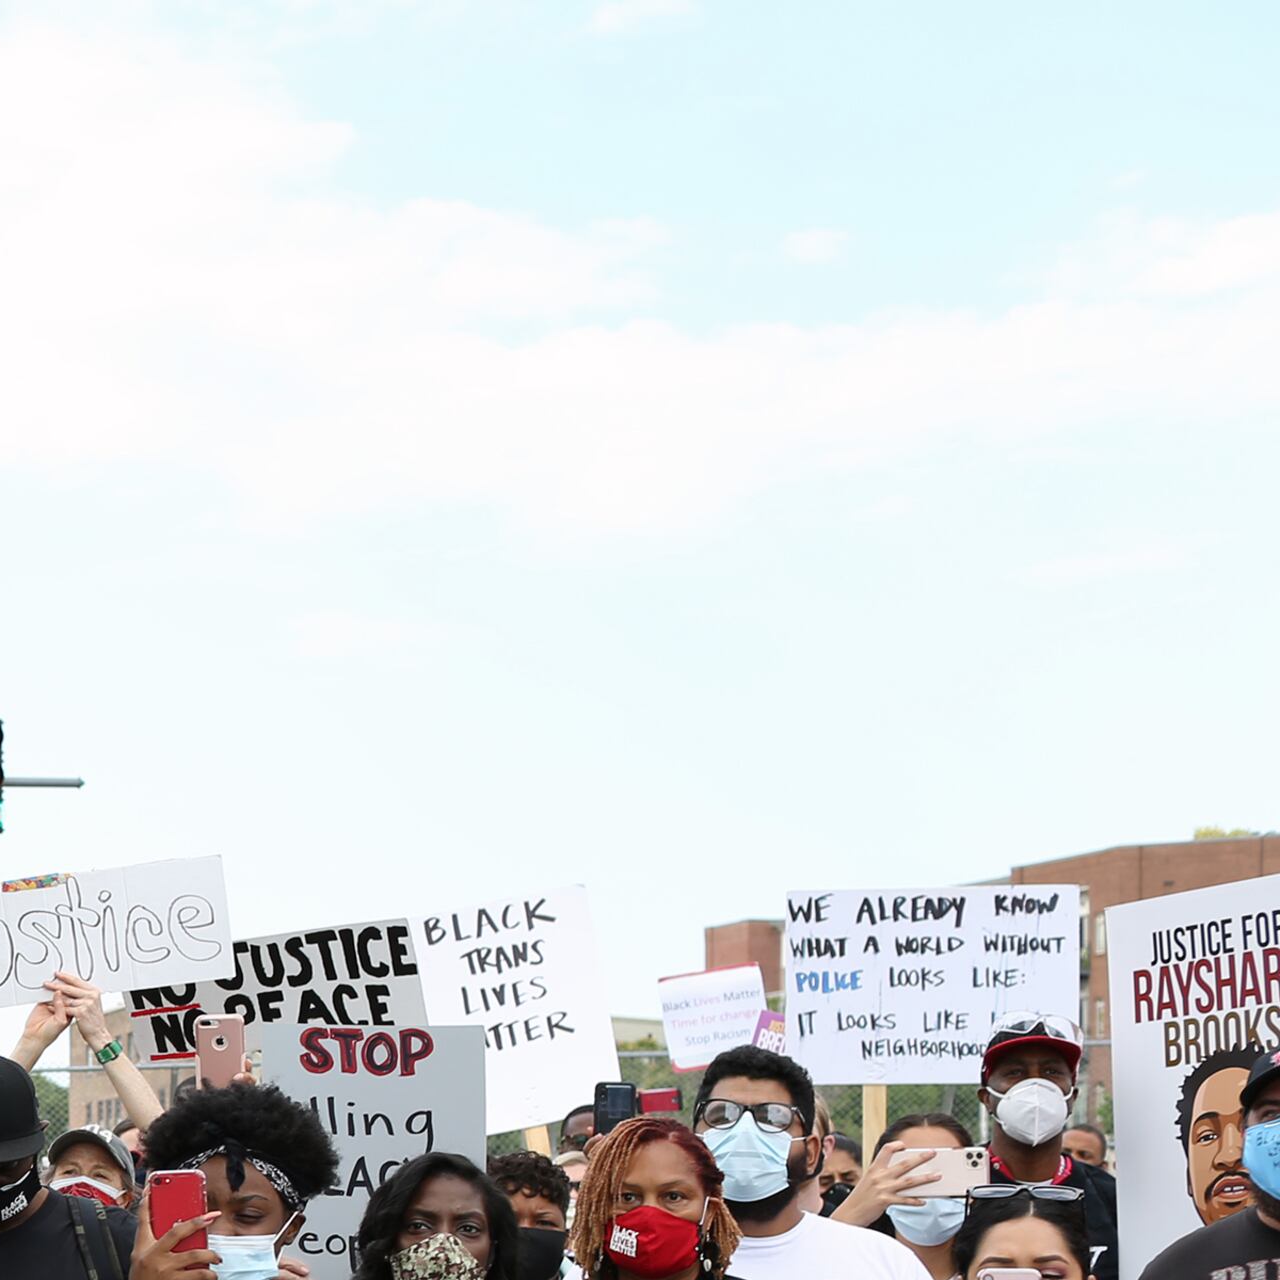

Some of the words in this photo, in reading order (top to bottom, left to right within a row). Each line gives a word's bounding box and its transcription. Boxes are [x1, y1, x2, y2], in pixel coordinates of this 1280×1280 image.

[423, 898, 557, 946] BLACK
[788, 893, 835, 923] WE
[856, 894, 966, 928] ALREADY
[994, 892, 1059, 916] KNOW
[215, 925, 418, 991] JUSTICE
[460, 939, 545, 977] TRANS
[790, 935, 850, 959] WHAT
[863, 935, 880, 954] A
[895, 936, 965, 956] WORLD
[984, 933, 1066, 956] WITHOUT
[1151, 918, 1235, 966] JUSTICE
[460, 977, 548, 1016] LIVES
[796, 969, 863, 994] POLICE
[889, 966, 945, 991] LOOKS
[972, 966, 1026, 988] LIKE:
[798, 1010, 818, 1037] IT
[837, 1010, 896, 1032] LOOKS
[923, 1009, 970, 1033] LIKE
[299, 1027, 434, 1077] STOP
